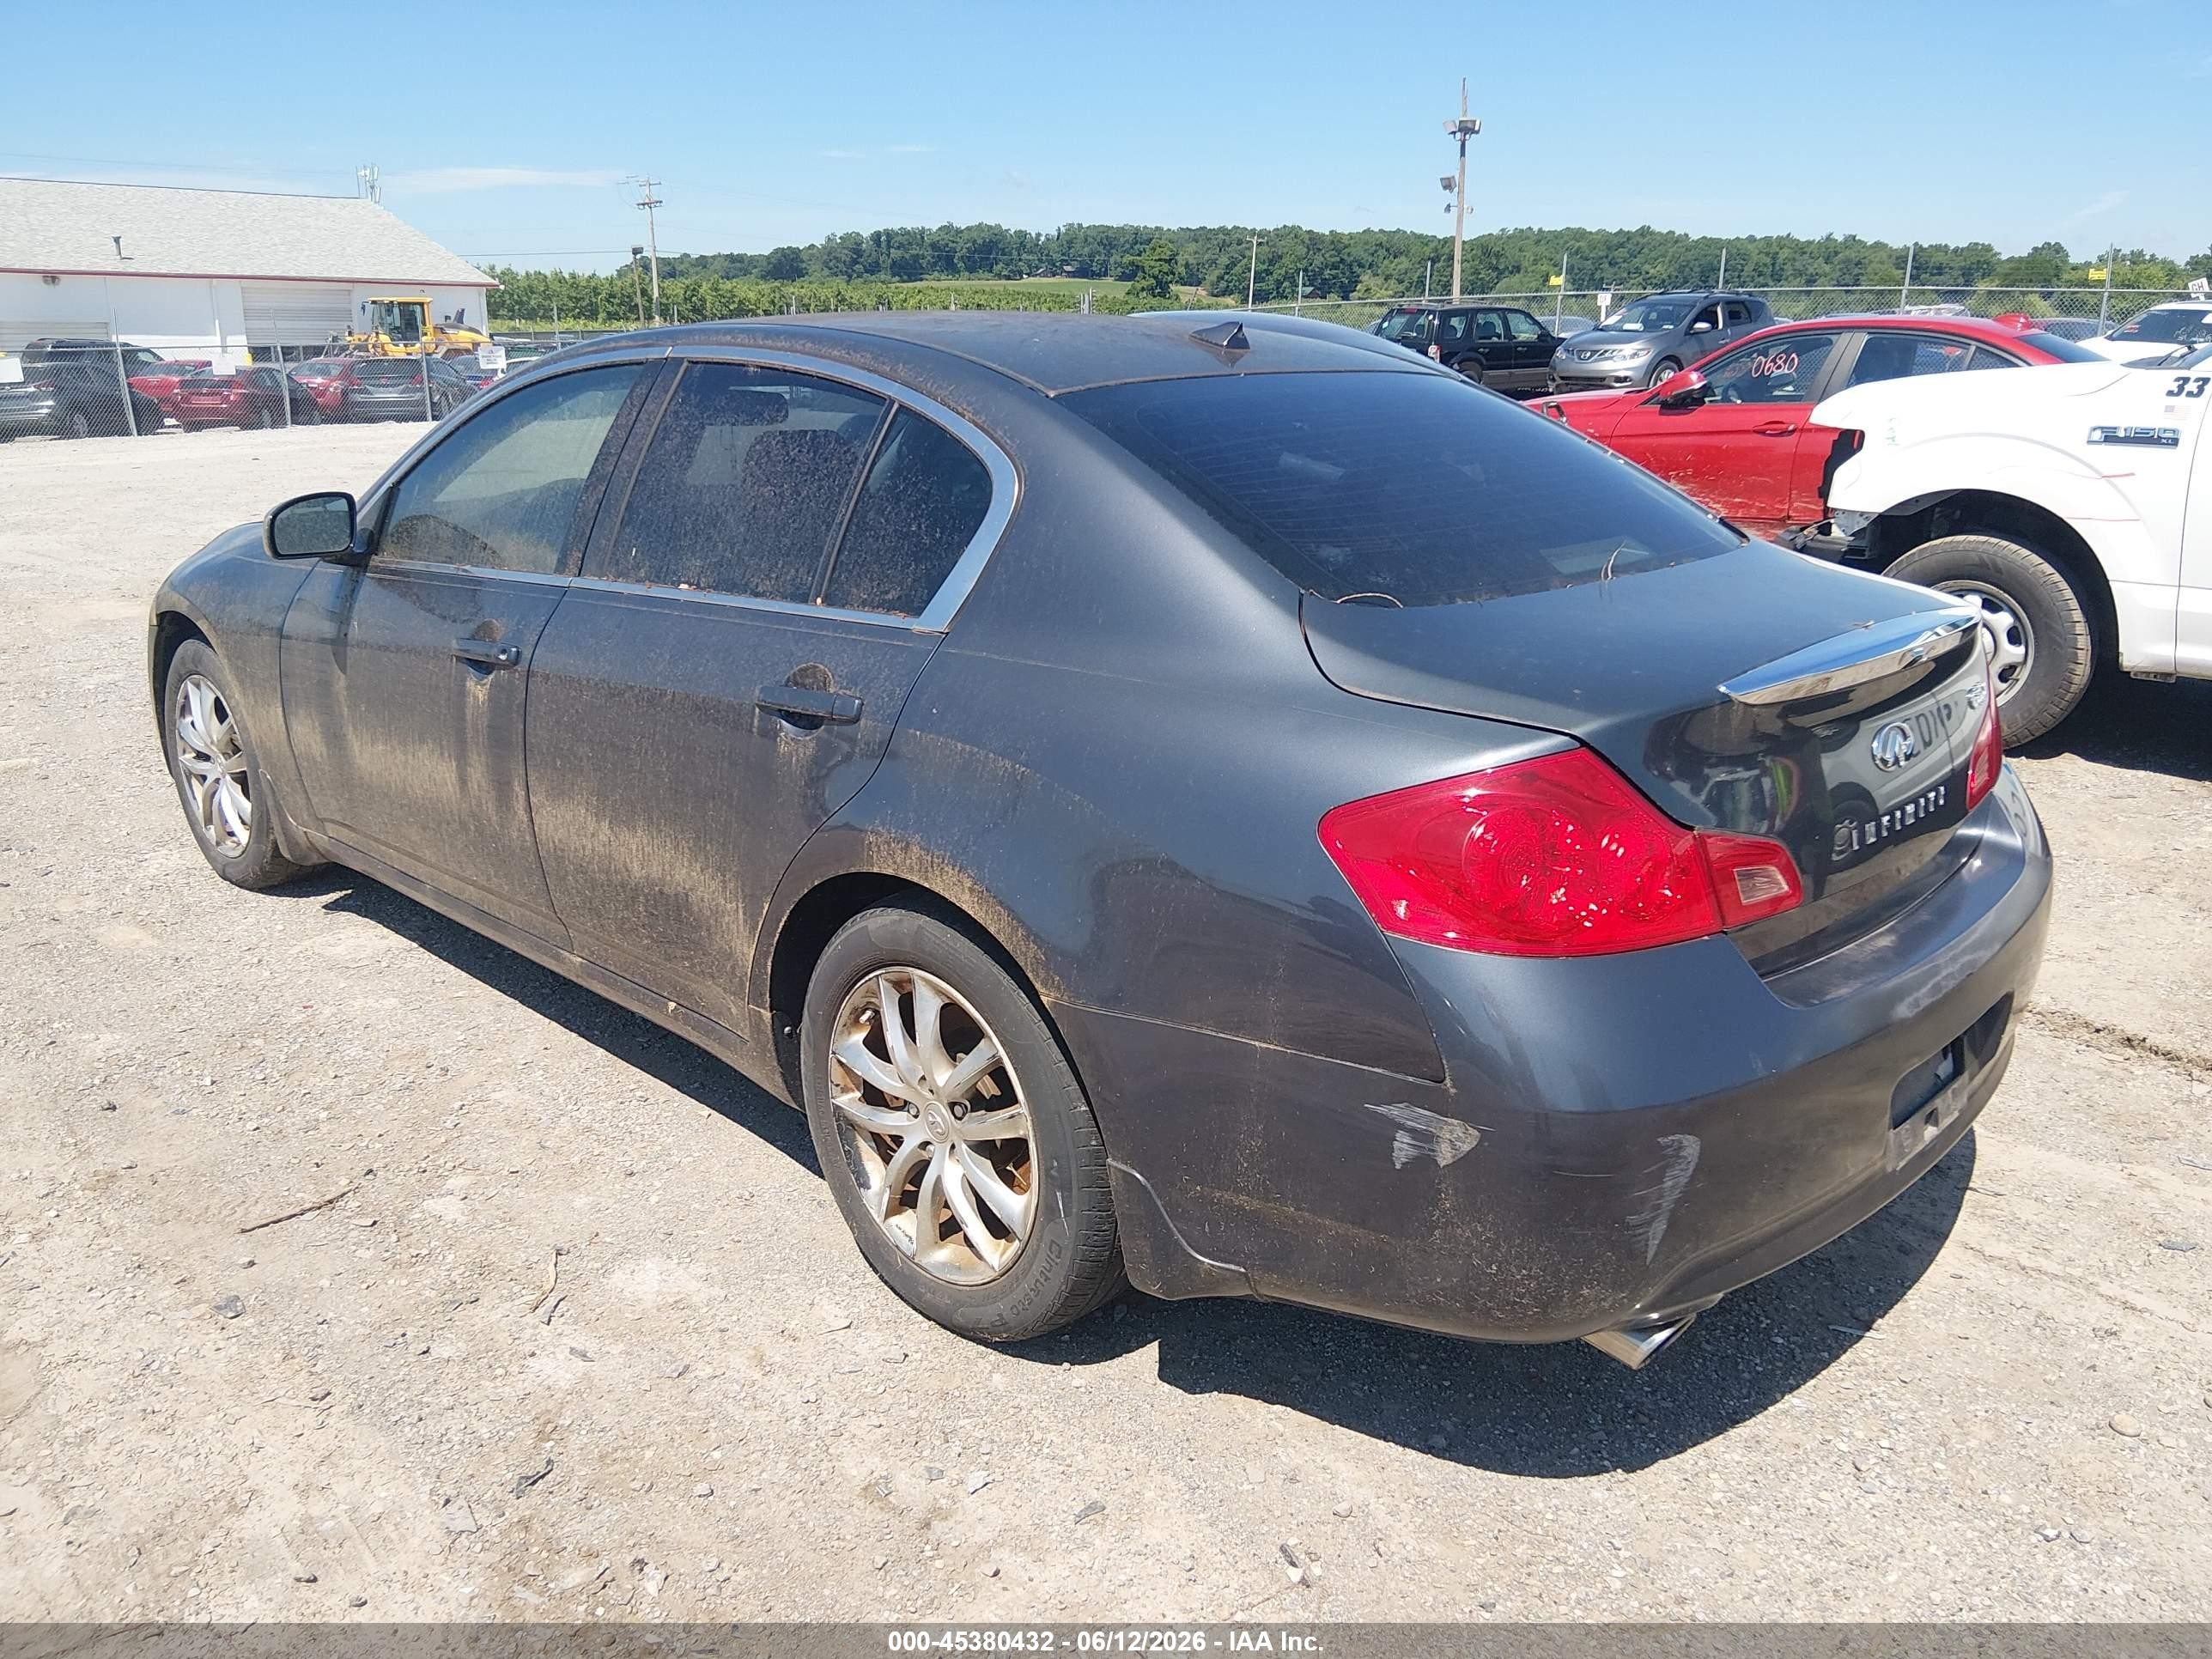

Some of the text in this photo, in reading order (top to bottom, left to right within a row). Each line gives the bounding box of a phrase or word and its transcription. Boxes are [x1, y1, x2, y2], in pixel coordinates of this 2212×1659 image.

[1751, 352, 1799, 378] 0680
[2165, 376, 2211, 398] 33
[1850, 785, 1945, 851] INFINITI
